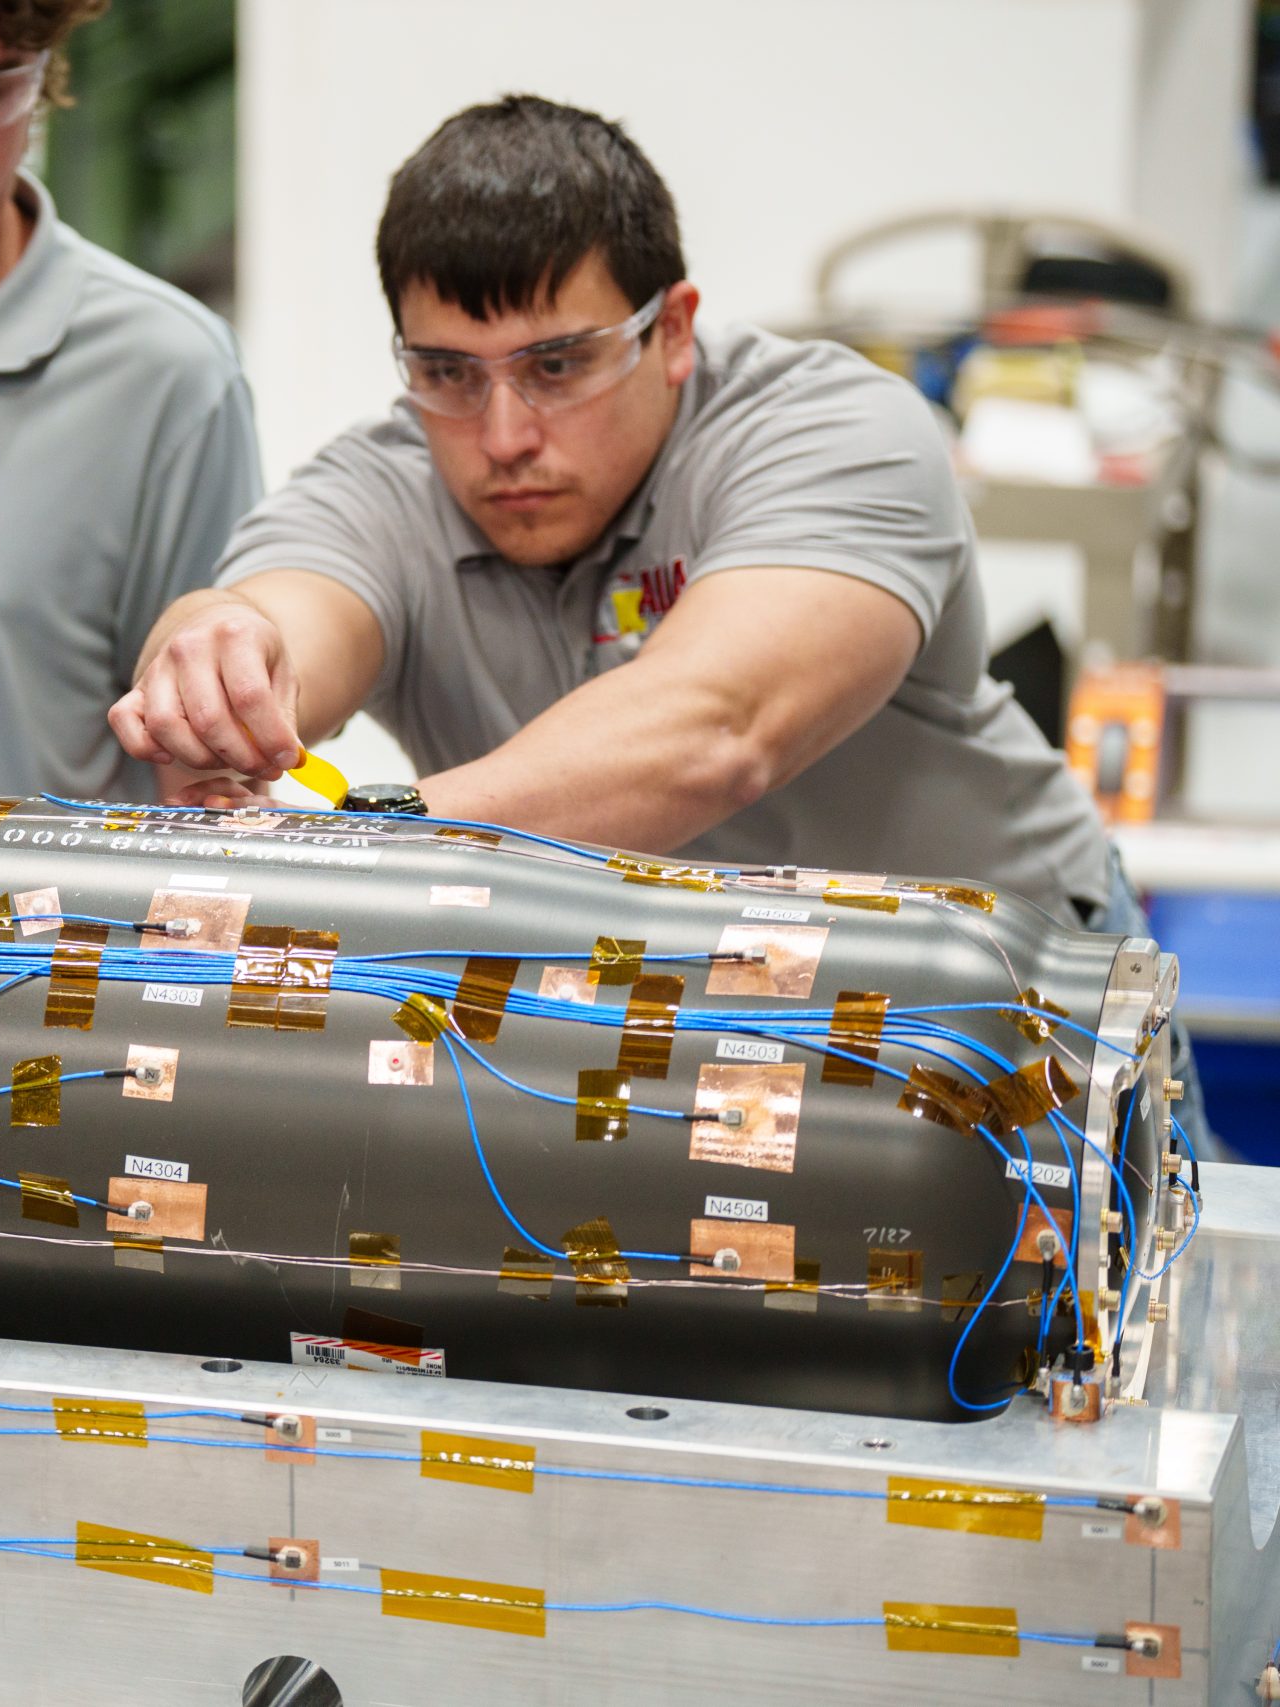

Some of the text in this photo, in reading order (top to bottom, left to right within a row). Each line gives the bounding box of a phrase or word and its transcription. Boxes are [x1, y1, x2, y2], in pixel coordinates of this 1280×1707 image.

[748, 908, 802, 920] N4502
[146, 986, 198, 1003] N4303
[724, 1042, 778, 1060] N4503
[132, 1158, 183, 1179] N4304
[710, 1199, 764, 1218] N4504
